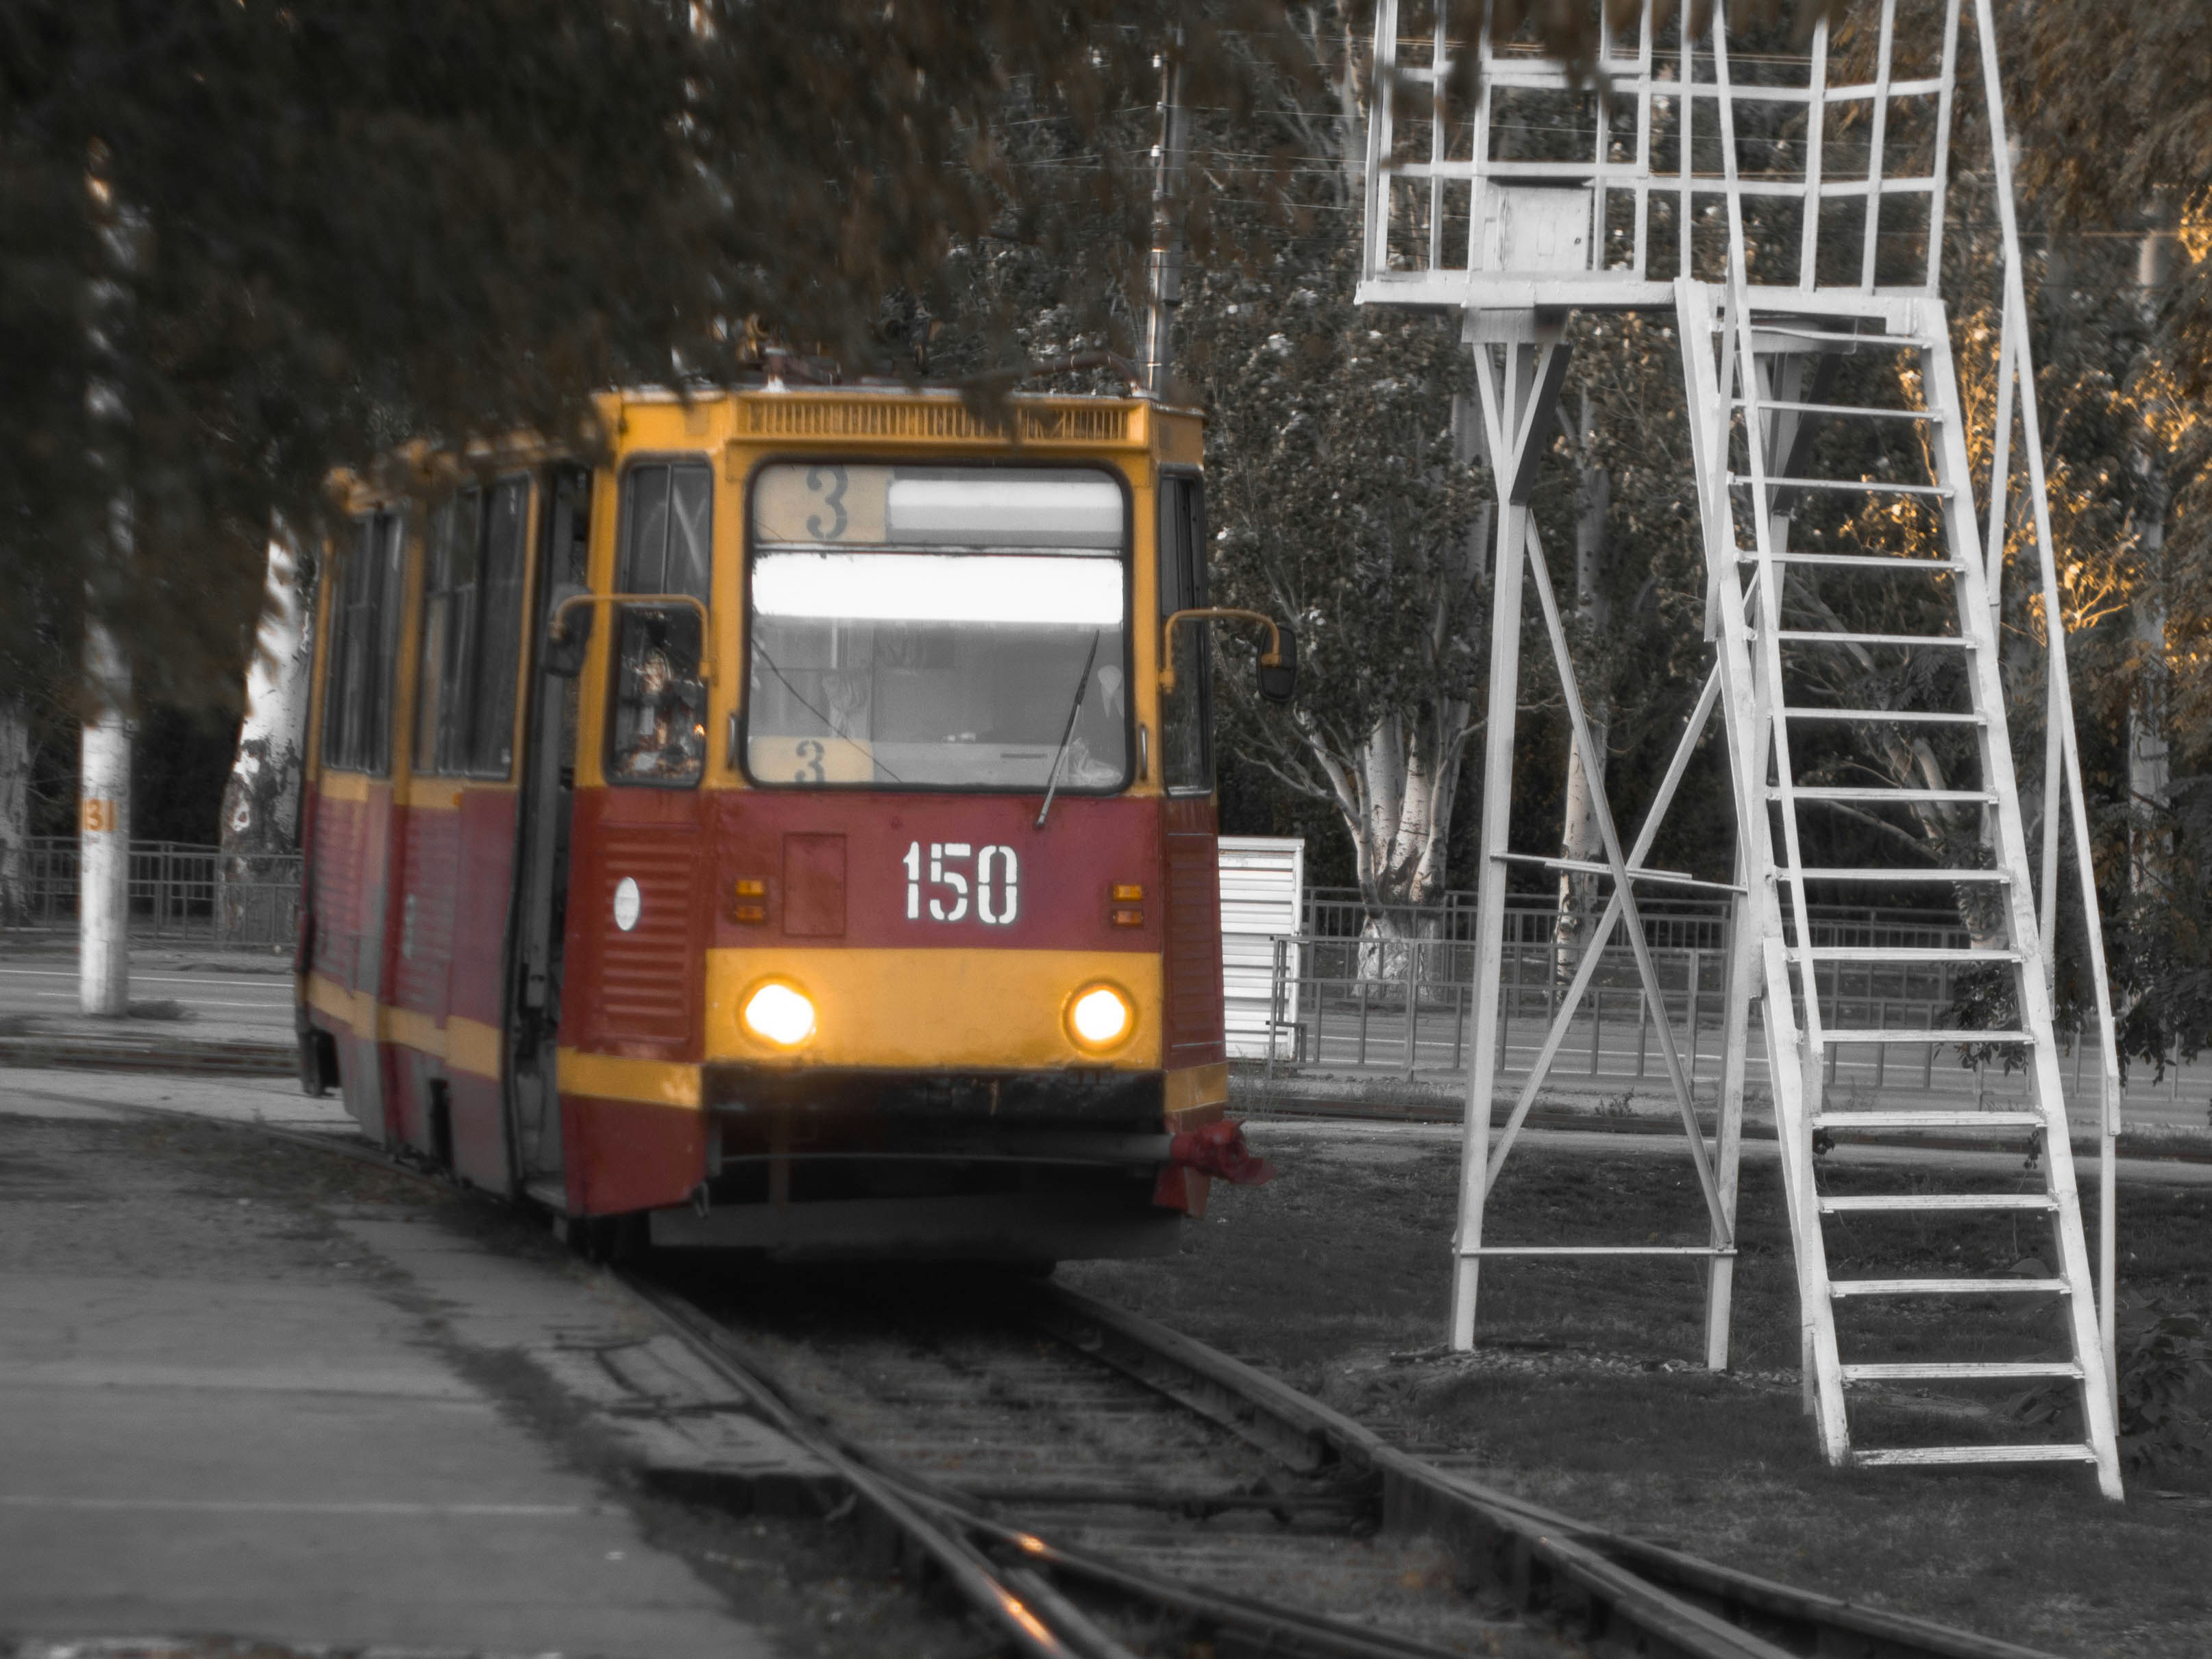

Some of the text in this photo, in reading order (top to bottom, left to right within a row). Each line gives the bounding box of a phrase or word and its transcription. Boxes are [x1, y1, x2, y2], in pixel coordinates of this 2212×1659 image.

[806, 465, 848, 539] 3
[795, 739, 825, 783] 3
[902, 841, 1018, 924] 150
